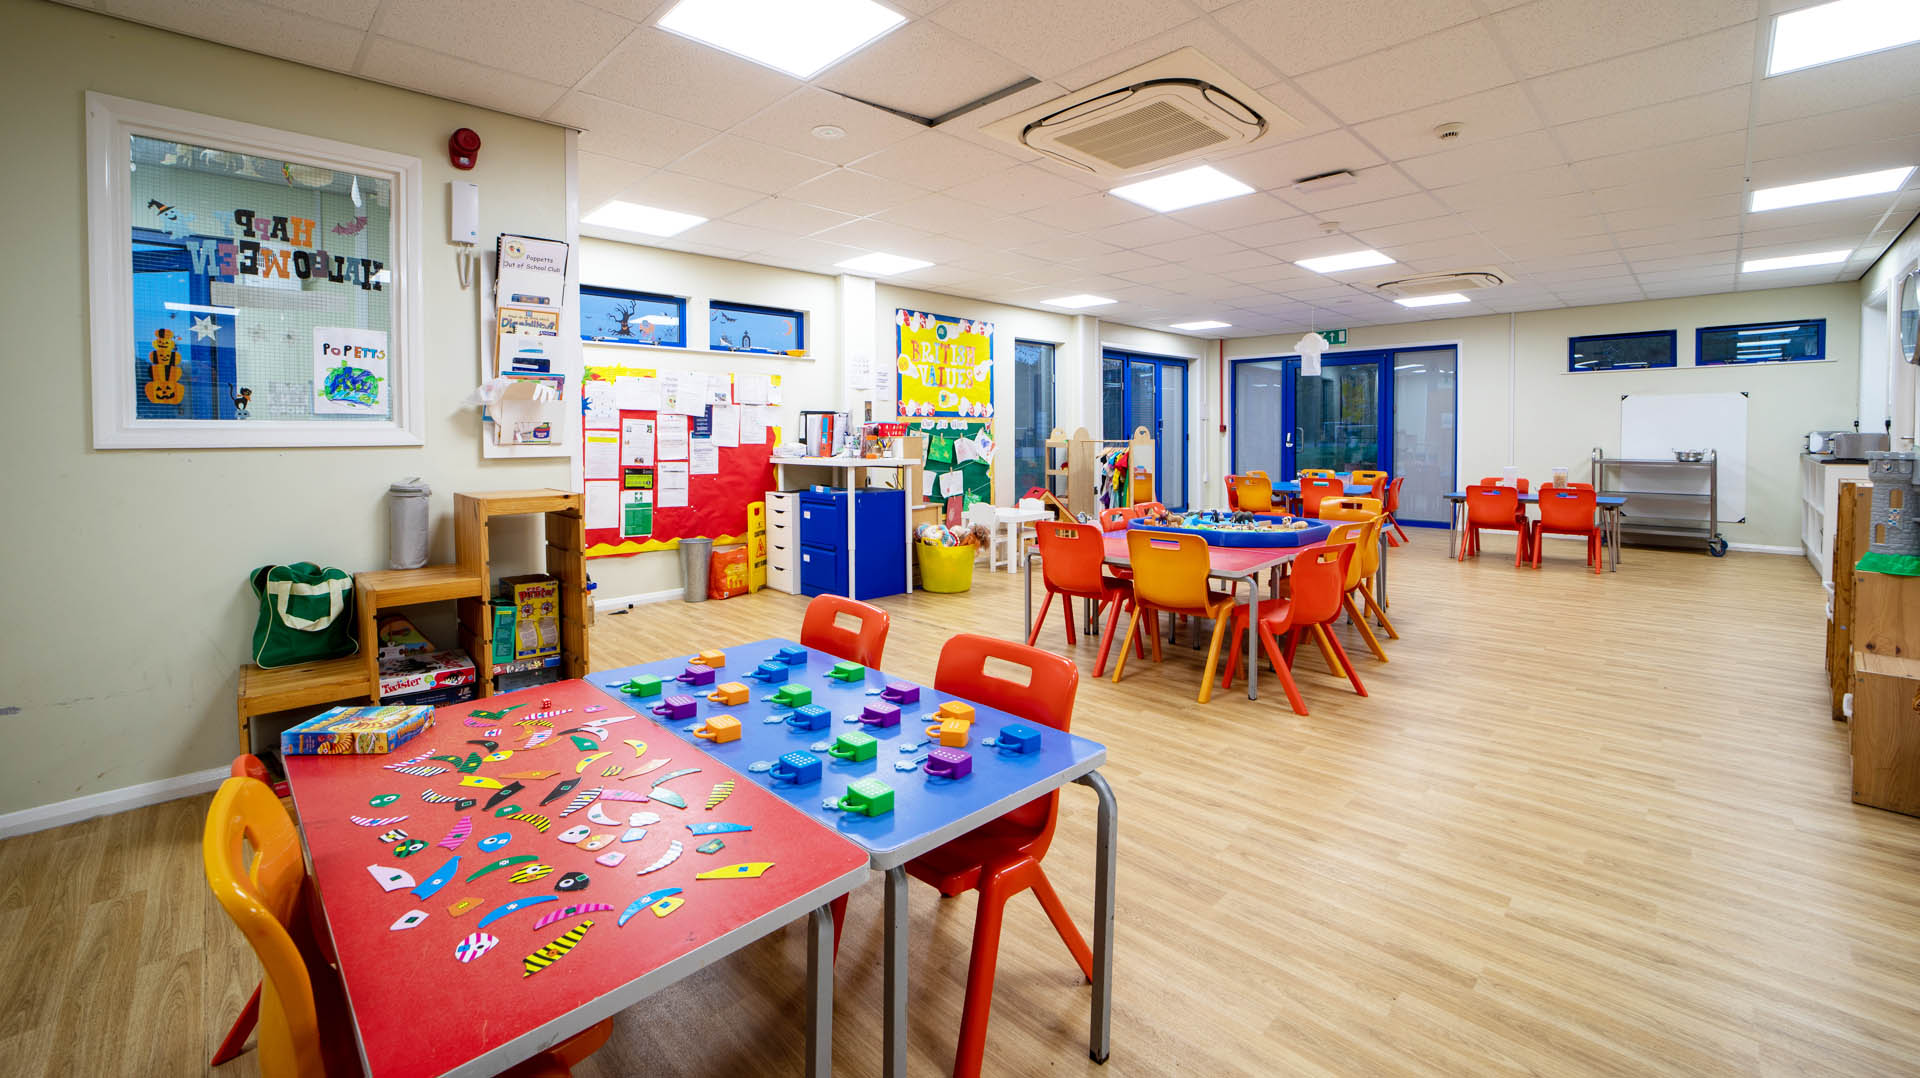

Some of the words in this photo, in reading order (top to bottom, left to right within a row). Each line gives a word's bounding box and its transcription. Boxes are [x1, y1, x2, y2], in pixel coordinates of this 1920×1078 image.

[526, 263, 547, 271] School
[911, 340, 976, 367] BRITISH
[918, 364, 974, 389] VALUES
[382, 677, 422, 695] Twister
